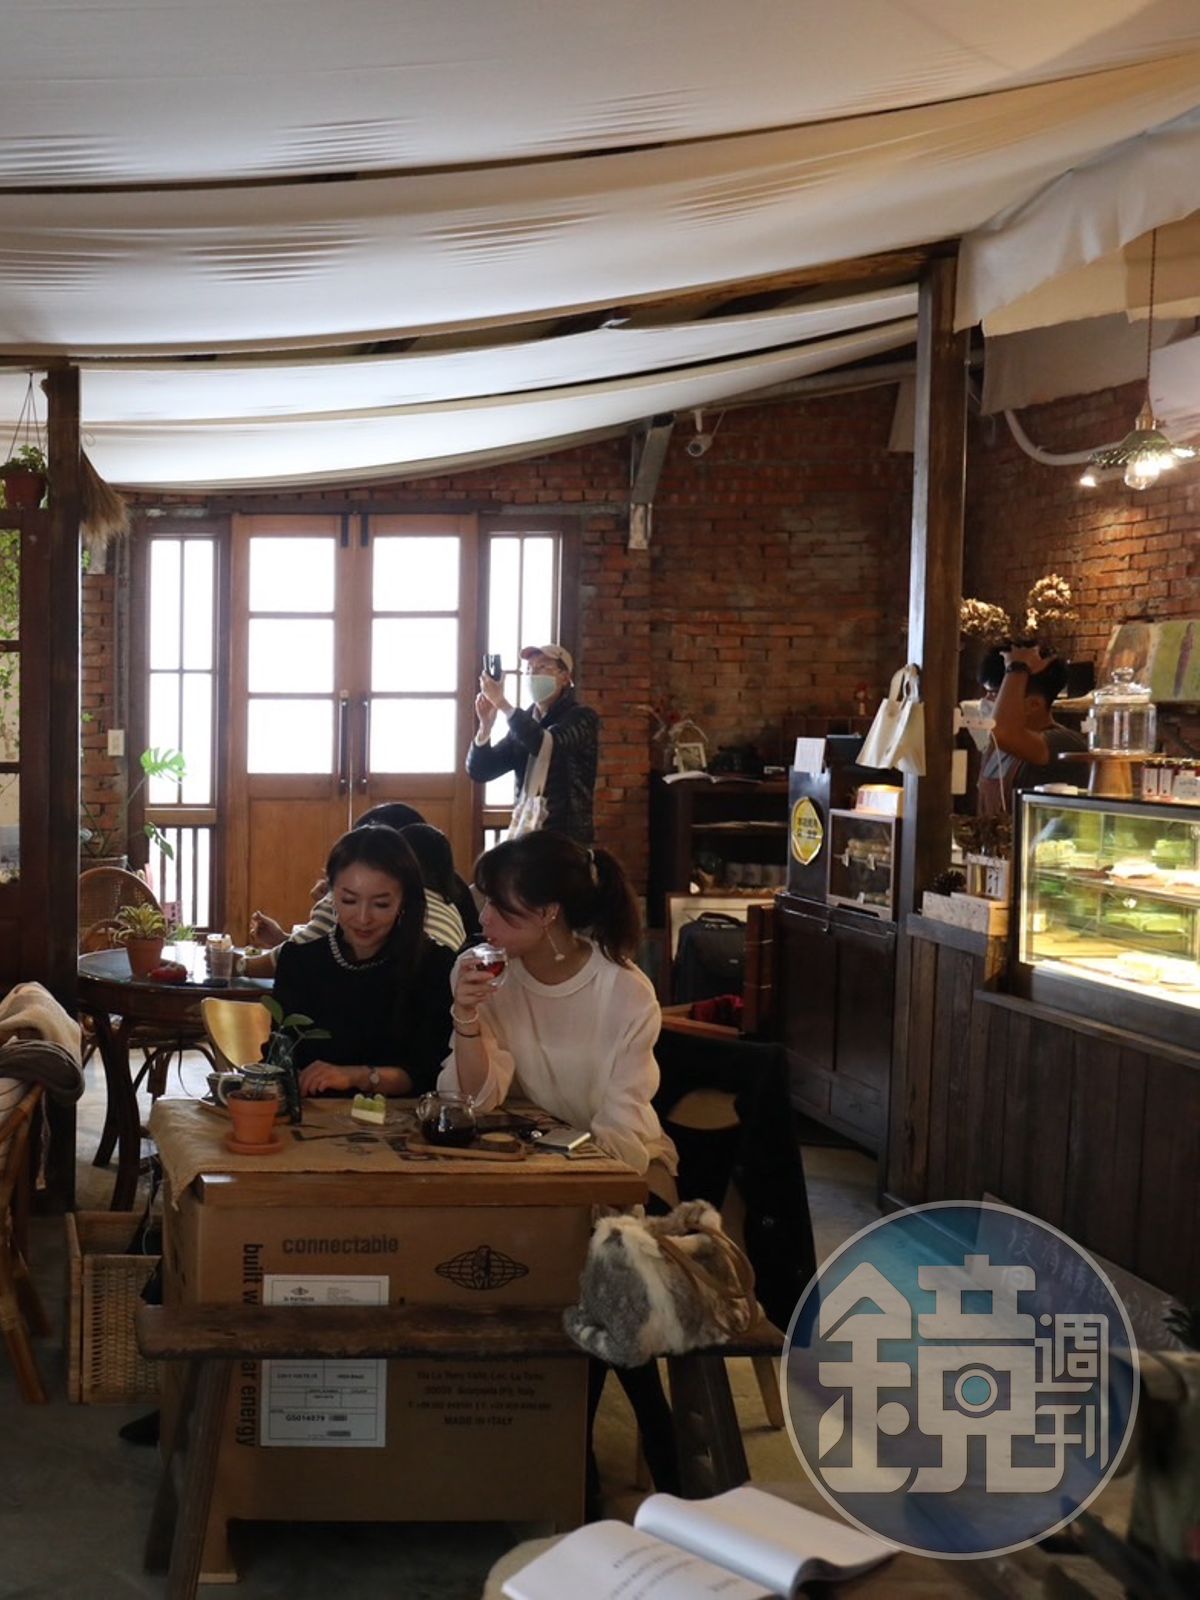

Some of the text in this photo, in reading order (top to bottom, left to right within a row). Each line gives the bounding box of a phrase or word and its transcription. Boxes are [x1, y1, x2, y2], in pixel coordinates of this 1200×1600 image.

[243, 1244, 264, 1284] built
[282, 1234, 399, 1254] connectable
[236, 1386, 257, 1447] energy
